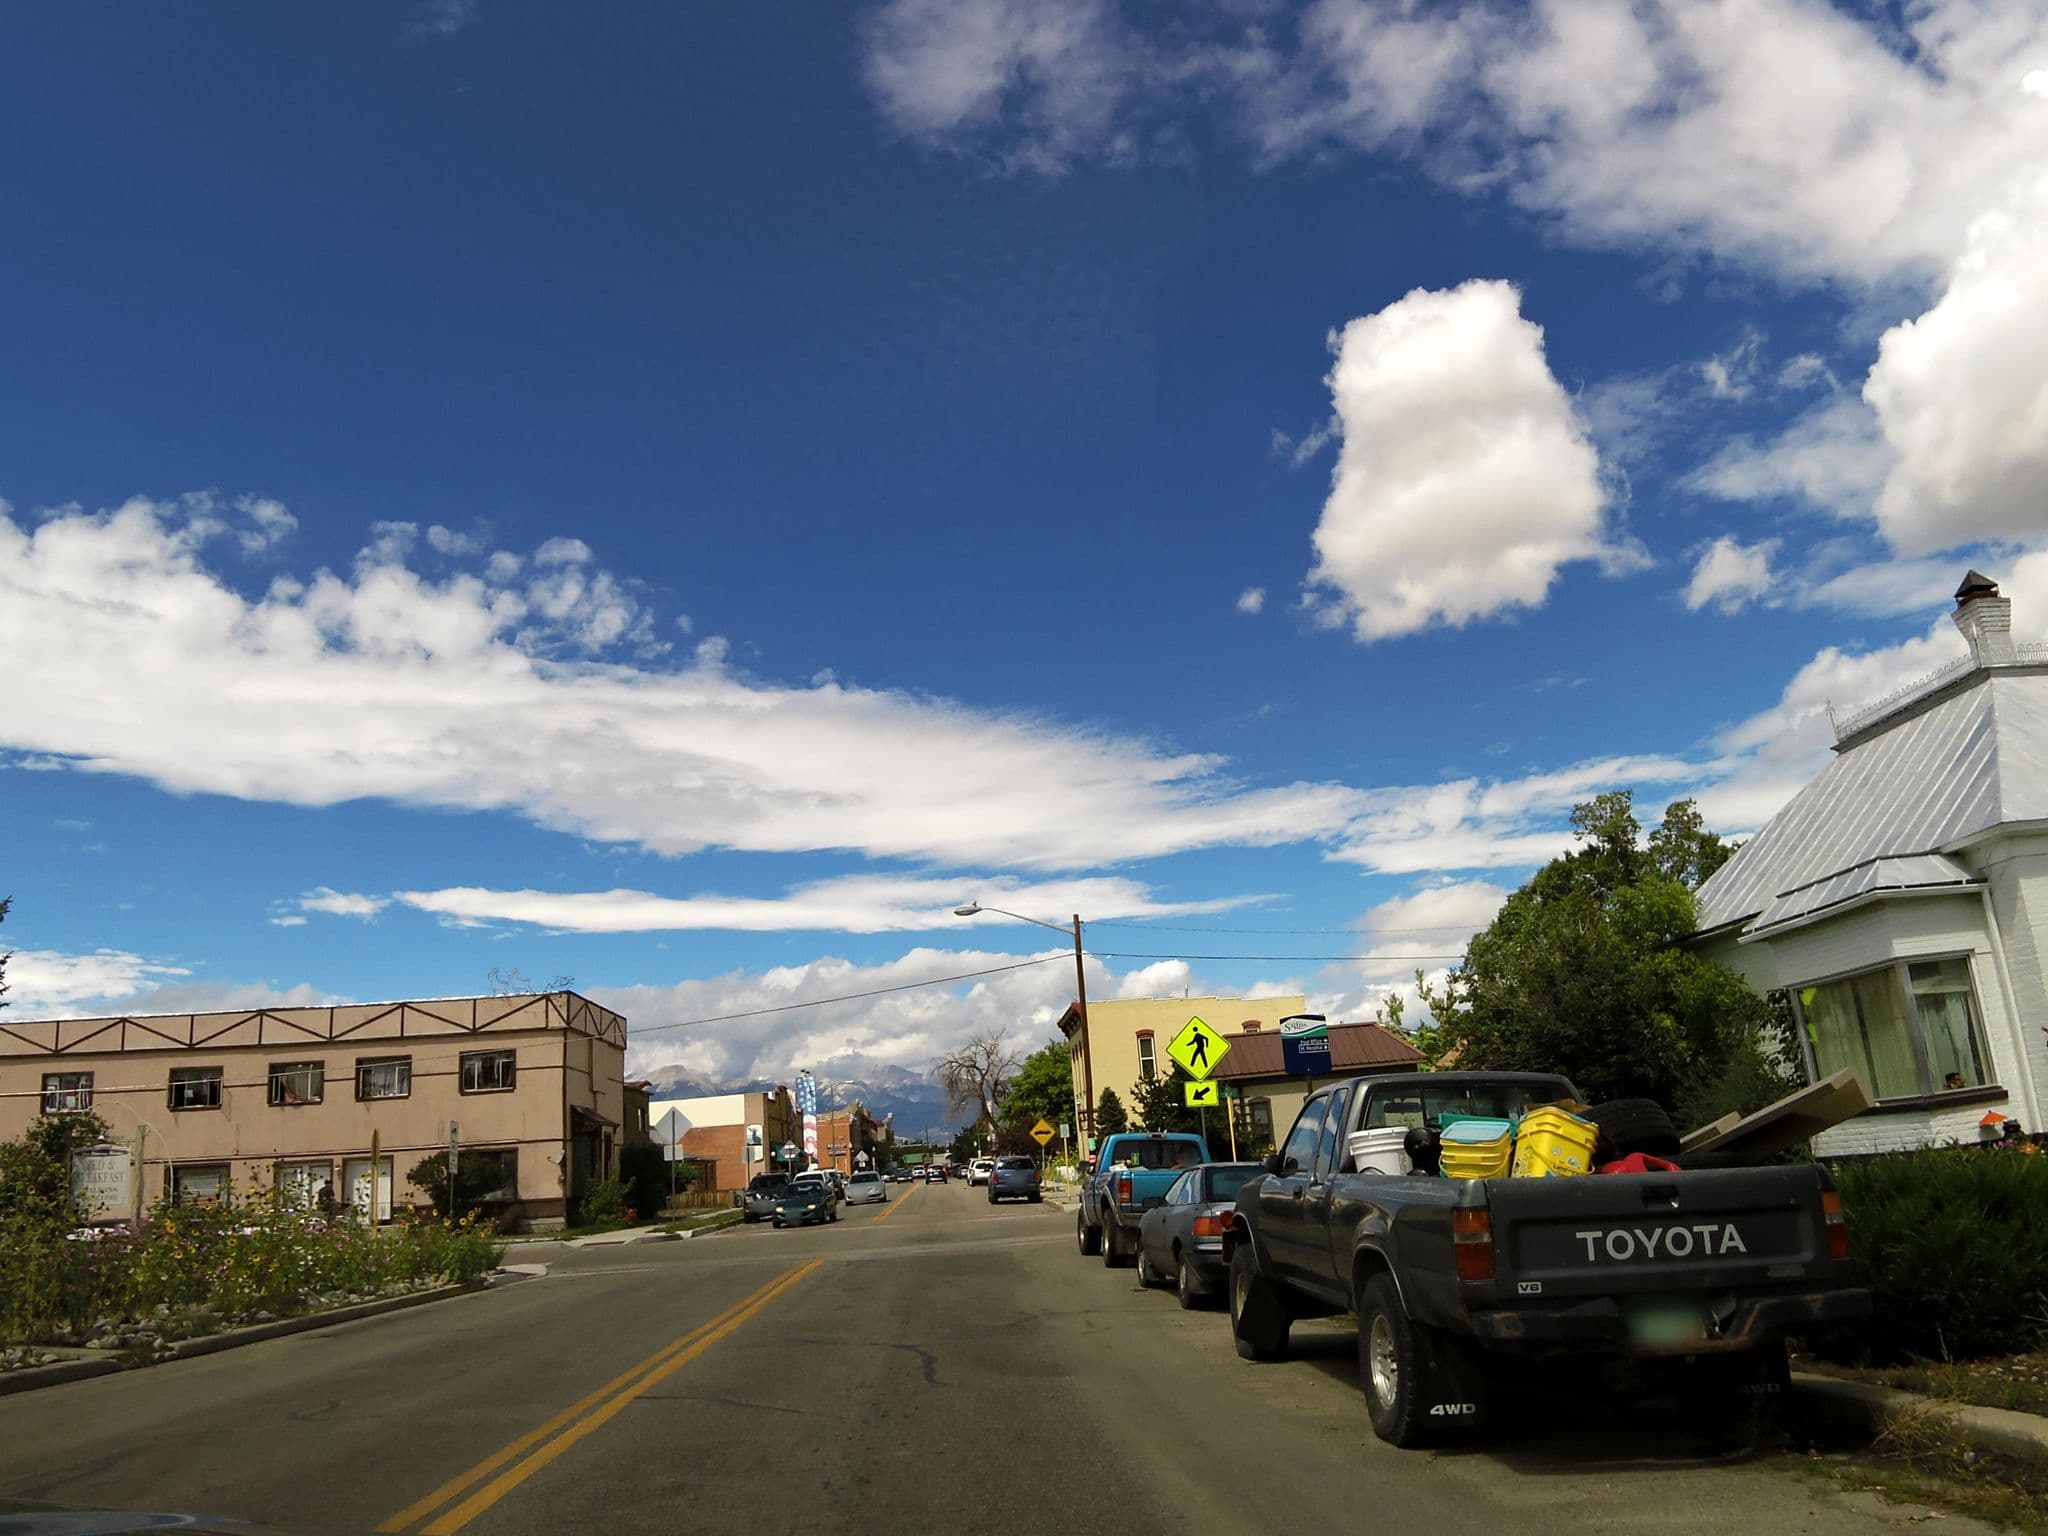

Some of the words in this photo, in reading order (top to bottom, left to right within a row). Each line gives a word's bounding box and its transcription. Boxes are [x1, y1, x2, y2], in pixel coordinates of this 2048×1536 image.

[1576, 1224, 1747, 1261] TOYOTA
[1519, 1283, 1541, 1292] V6
[1430, 1403, 1476, 1416] 4WD
